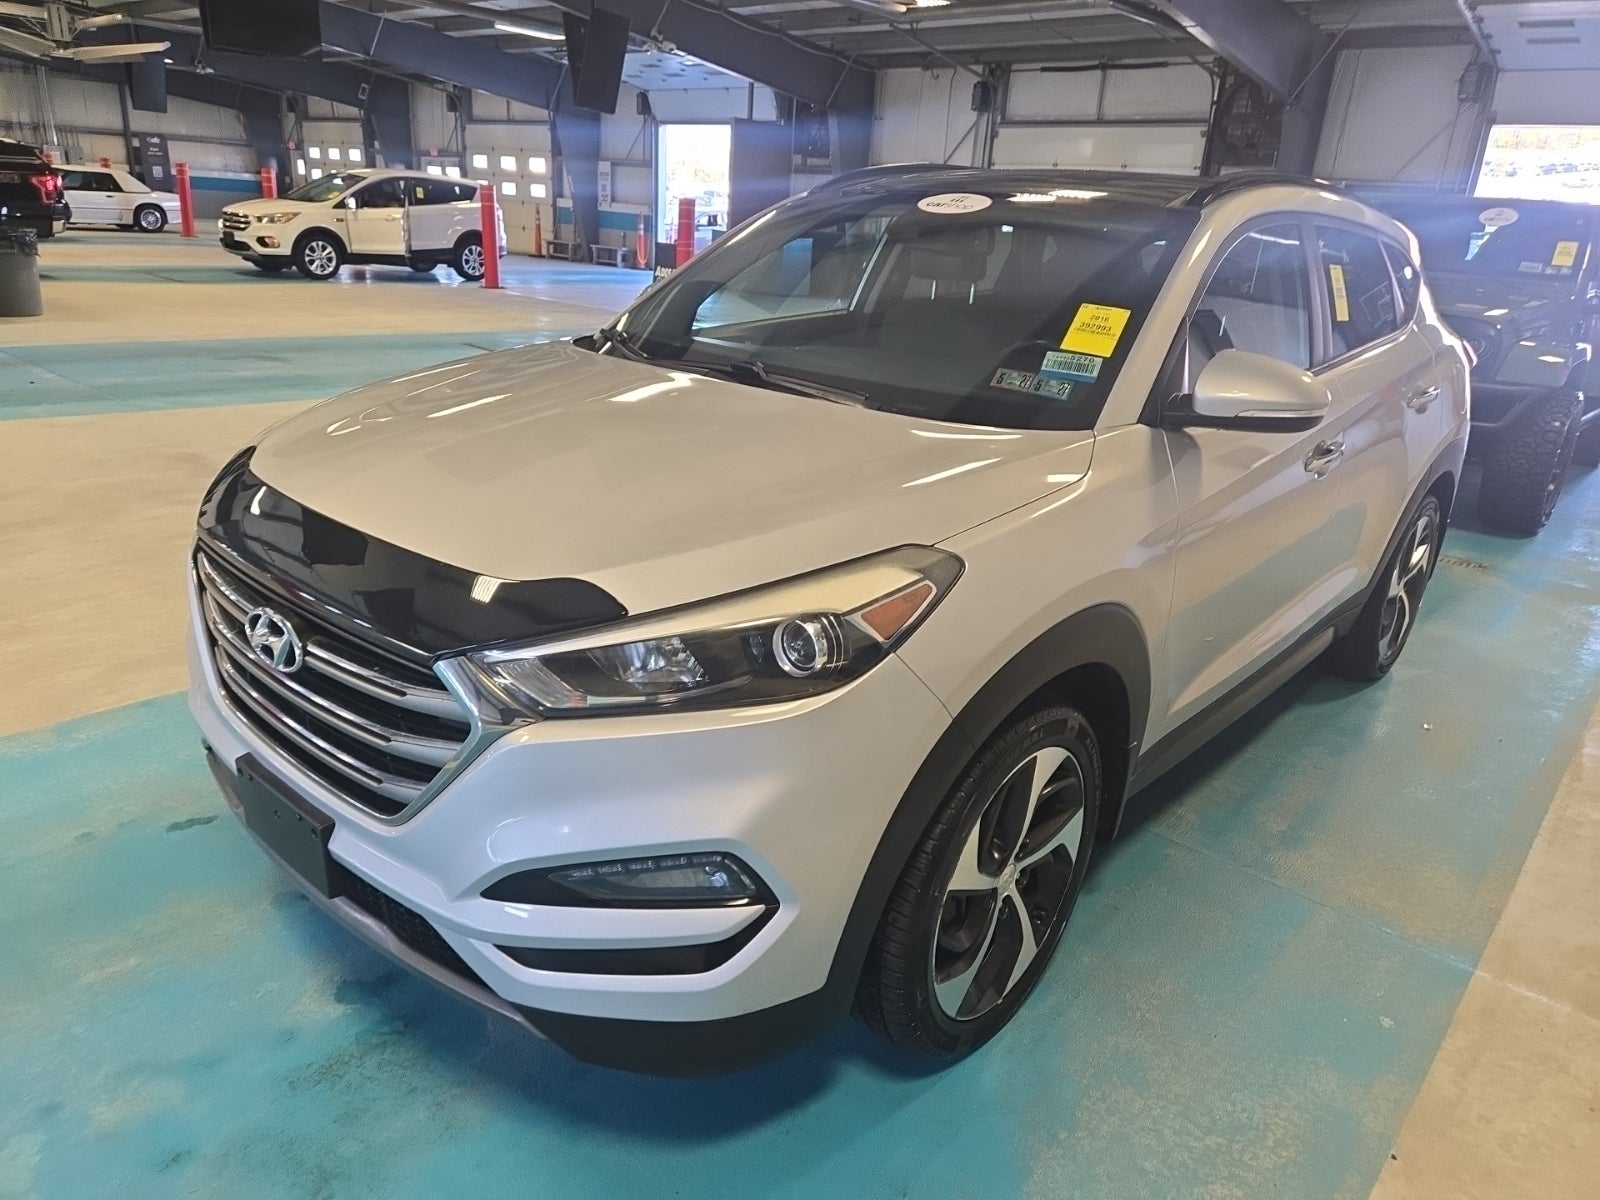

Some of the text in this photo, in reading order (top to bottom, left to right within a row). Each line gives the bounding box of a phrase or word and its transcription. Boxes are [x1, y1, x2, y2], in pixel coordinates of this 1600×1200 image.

[1089, 314, 1109, 322] 2016
[1079, 321, 1112, 332] 392993
[996, 373, 1006, 384] 5
